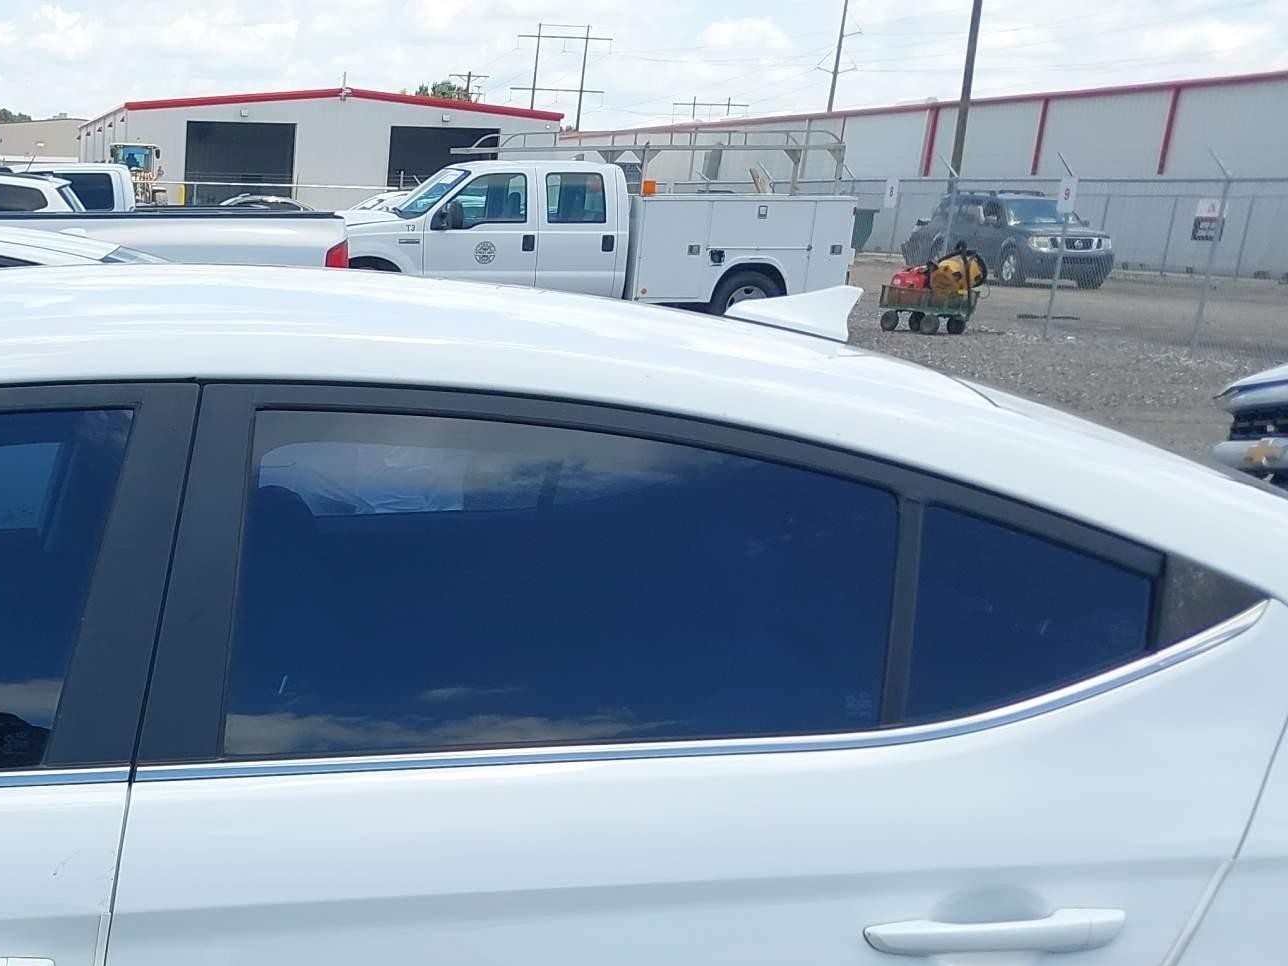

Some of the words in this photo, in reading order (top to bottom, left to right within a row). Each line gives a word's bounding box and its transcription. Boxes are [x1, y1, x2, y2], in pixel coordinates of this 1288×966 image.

[889, 186, 895, 198] 8
[1064, 188, 1071, 201] 9
[405, 224, 416, 232] T3
